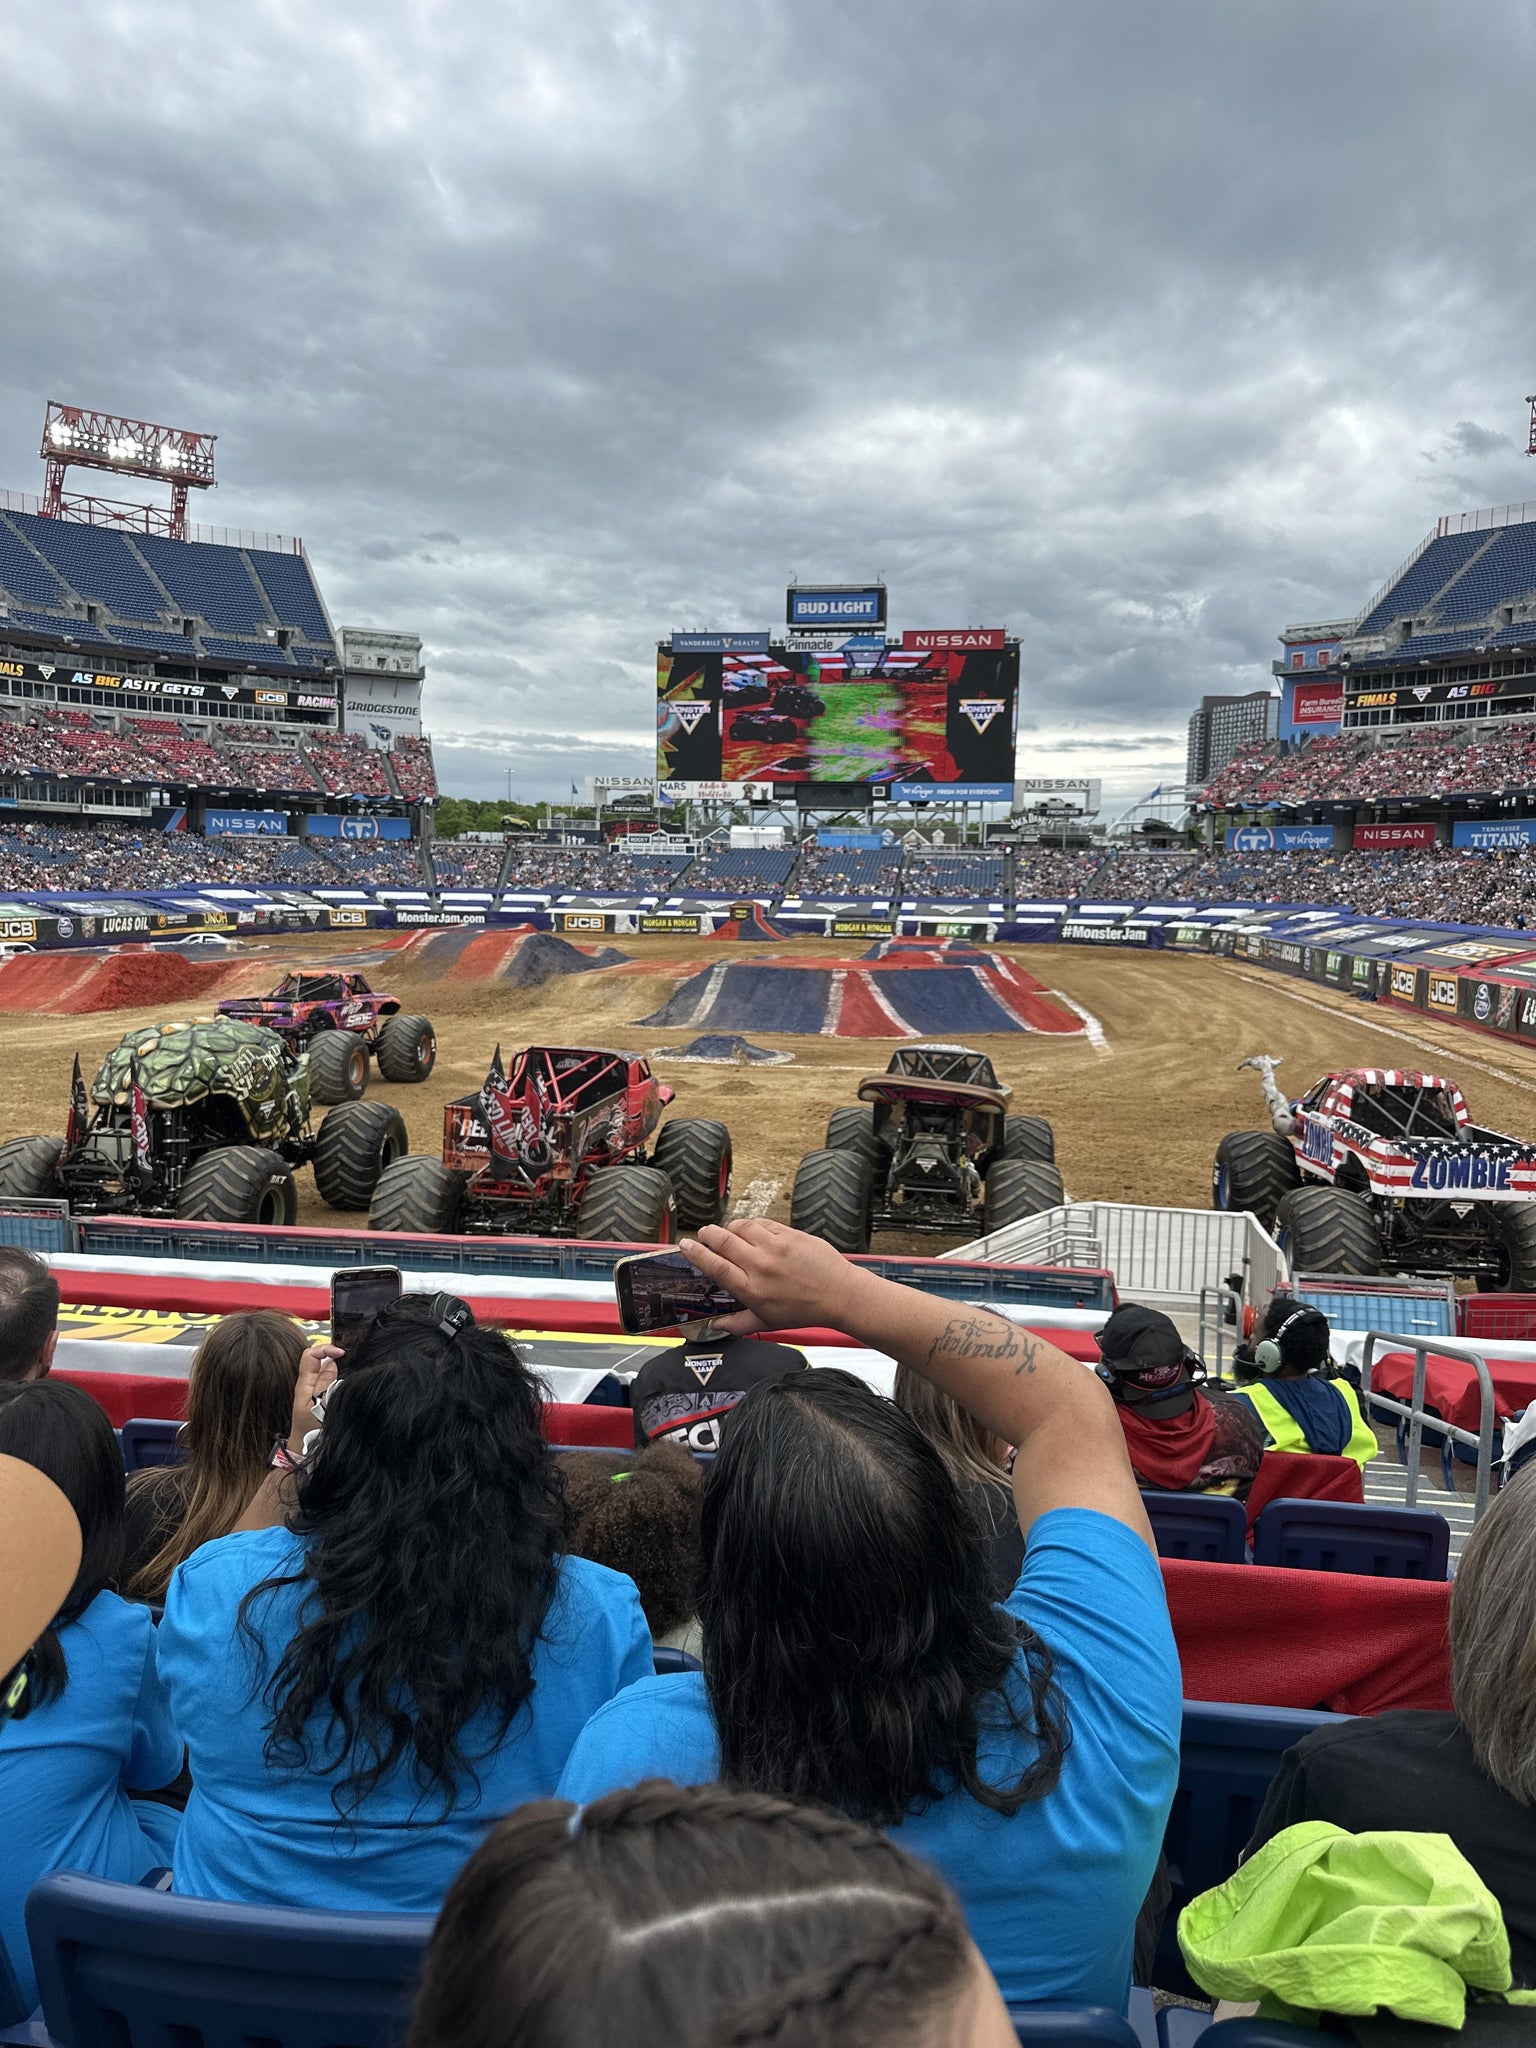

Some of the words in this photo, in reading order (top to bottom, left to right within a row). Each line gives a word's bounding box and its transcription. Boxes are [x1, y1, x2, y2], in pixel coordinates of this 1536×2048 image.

[797, 602, 829, 614] BUD
[830, 601, 874, 613] LIGHT
[787, 638, 833, 650] Pinnacle
[915, 634, 992, 646] NISSAN
[0, 661, 24, 677] ALS
[71, 672, 93, 684] AS
[95, 675, 121, 688] BIG
[122, 679, 143, 690] AS
[144, 681, 160, 692] IT
[162, 683, 205, 696] GETS!
[1446, 685, 1467, 699] AS
[1470, 683, 1496, 696] BIG
[257, 693, 286, 703] JCB
[297, 695, 339, 708] RACING
[1356, 692, 1397, 707] FINALS
[346, 701, 420, 716] BRIDGESTONE
[958, 705, 1005, 713] MONSTER
[972, 712, 993, 720] JAM
[595, 777, 653, 785] NISSAN
[660, 782, 687, 790] MARS
[1025, 780, 1090, 788] NISSAN
[211, 817, 282, 830] NISSAN
[1363, 829, 1424, 840] NISSAN
[1471, 832, 1529, 847] TITANS
[332, 912, 363, 923] JCB
[397, 912, 485, 923] MonsterJam.com
[568, 917, 602, 928] JCB
[0, 922, 34, 937] JCB
[102, 917, 133, 933] LUCAS
[134, 916, 149, 931] OIL
[935, 924, 973, 936] BKT
[1061, 925, 1147, 941] #MonsterJam
[1177, 929, 1202, 941] BKT
[1353, 962, 1370, 977] BKT
[1393, 968, 1415, 994] JCB
[1431, 980, 1456, 1005] JCB
[1302, 1117, 1334, 1167] ZOMBIE
[1410, 1154, 1514, 1191] ZOMBIE
[684, 1359, 723, 1367] MONSTER
